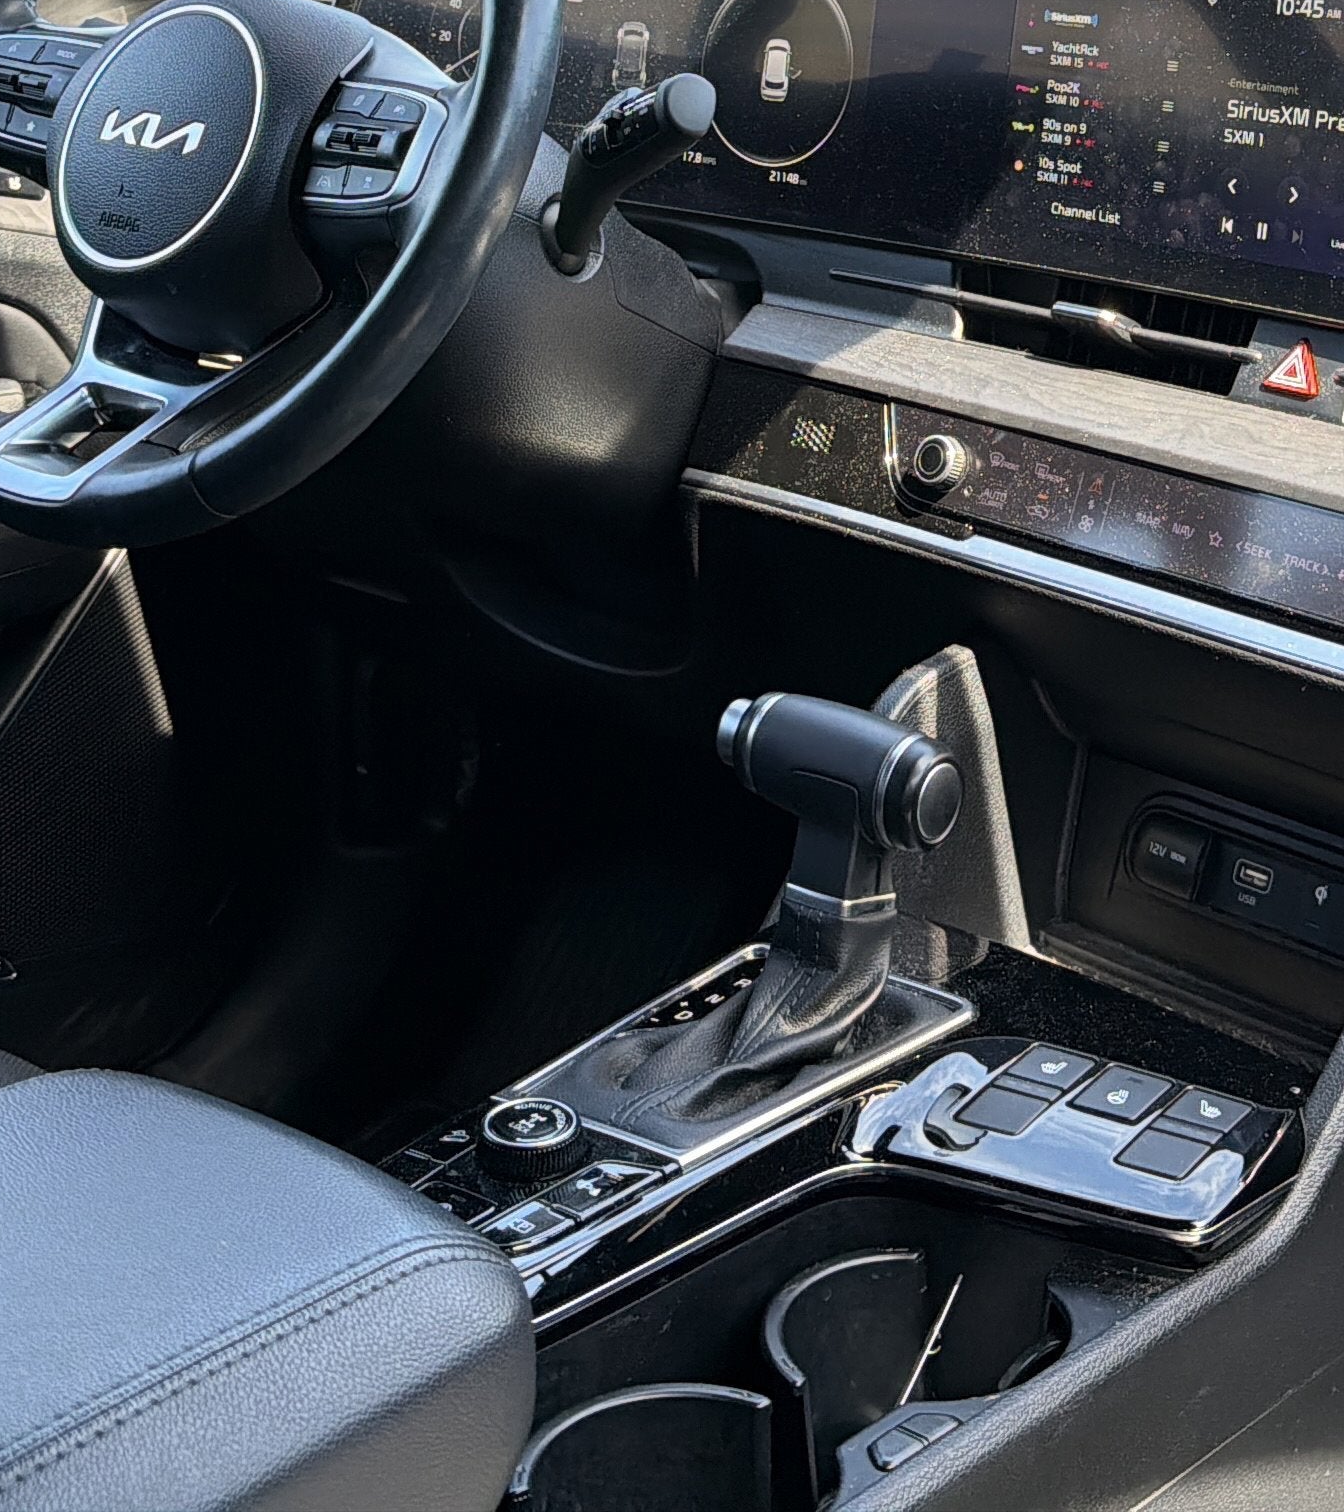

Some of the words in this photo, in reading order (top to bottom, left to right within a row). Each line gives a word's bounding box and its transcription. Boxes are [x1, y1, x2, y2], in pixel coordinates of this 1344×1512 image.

[1326, 9, 1342, 20] AM
[438, 30, 452, 42] 20
[1049, 54, 1072, 67] SXM
[1073, 57, 1084, 68] 15
[1047, 79, 1081, 95] Pop2K
[1229, 77, 1300, 95] Entertainment
[1045, 93, 1068, 106] SXM
[1069, 96, 1080, 108] 10
[1226, 99, 1310, 128] SiriusXM
[99, 108, 206, 155] KIA
[1042, 118, 1061, 131] 90s
[1063, 121, 1078, 133] on
[1079, 122, 1087, 135] 9
[1041, 132, 1063, 145] SXM
[1064, 134, 1072, 146] 9
[1223, 128, 1255, 146] SXM
[1258, 132, 1265, 148] 1
[1038, 156, 1055, 170] 10s
[1057, 159, 1083, 174] Spot
[768, 170, 800, 185] 21148
[1036, 171, 1058, 183] SXM
[1060, 173, 1068, 185] 11
[1050, 201, 1097, 221] Channel
[1098, 207, 1121, 225] List
[983, 488, 1007, 503] AUTO
[1172, 521, 1195, 540] NAV
[1243, 541, 1273, 561] SEEK
[1282, 553, 1321, 574] TRACK
[1148, 841, 1168, 858] 12V
[1237, 892, 1256, 906] USB
[520, 1102, 553, 1111] DRIVE
